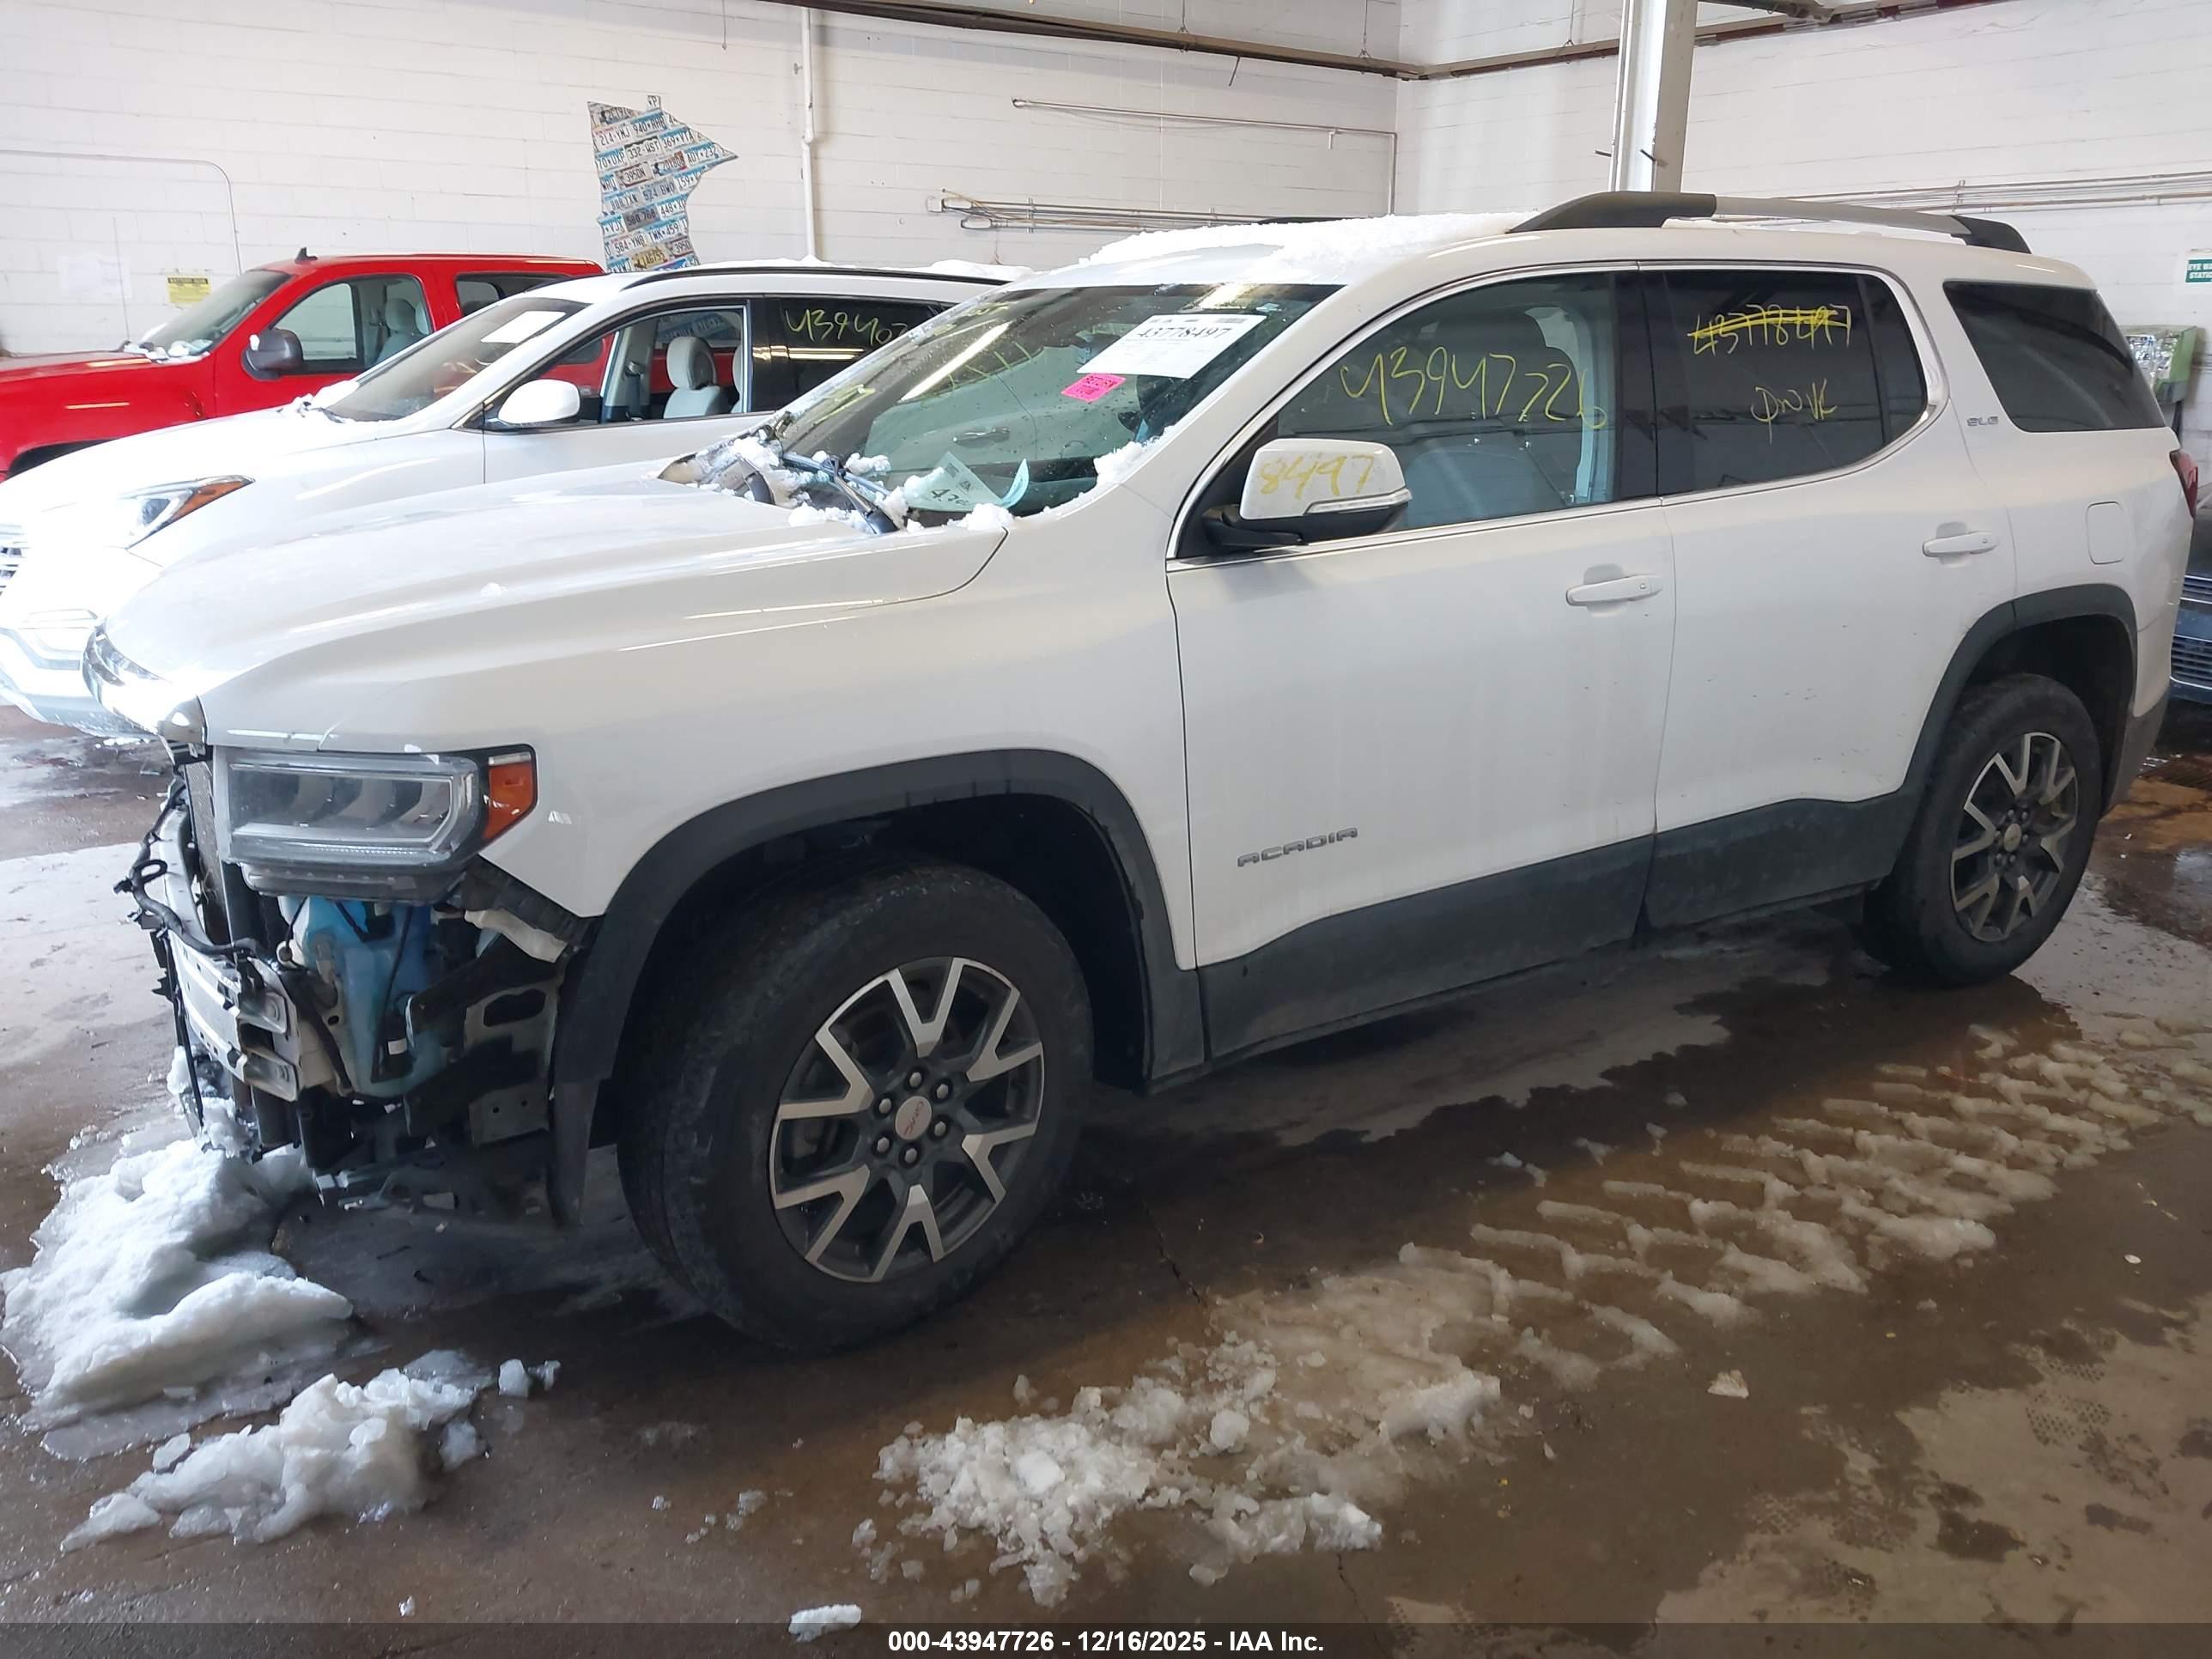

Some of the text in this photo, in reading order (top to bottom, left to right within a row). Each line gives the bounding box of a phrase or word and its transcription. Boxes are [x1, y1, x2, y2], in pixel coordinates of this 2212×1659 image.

[1340, 346, 1607, 429] 43947726
[1259, 453, 1374, 500] 8497
[1237, 827, 1358, 867] ACADIA
